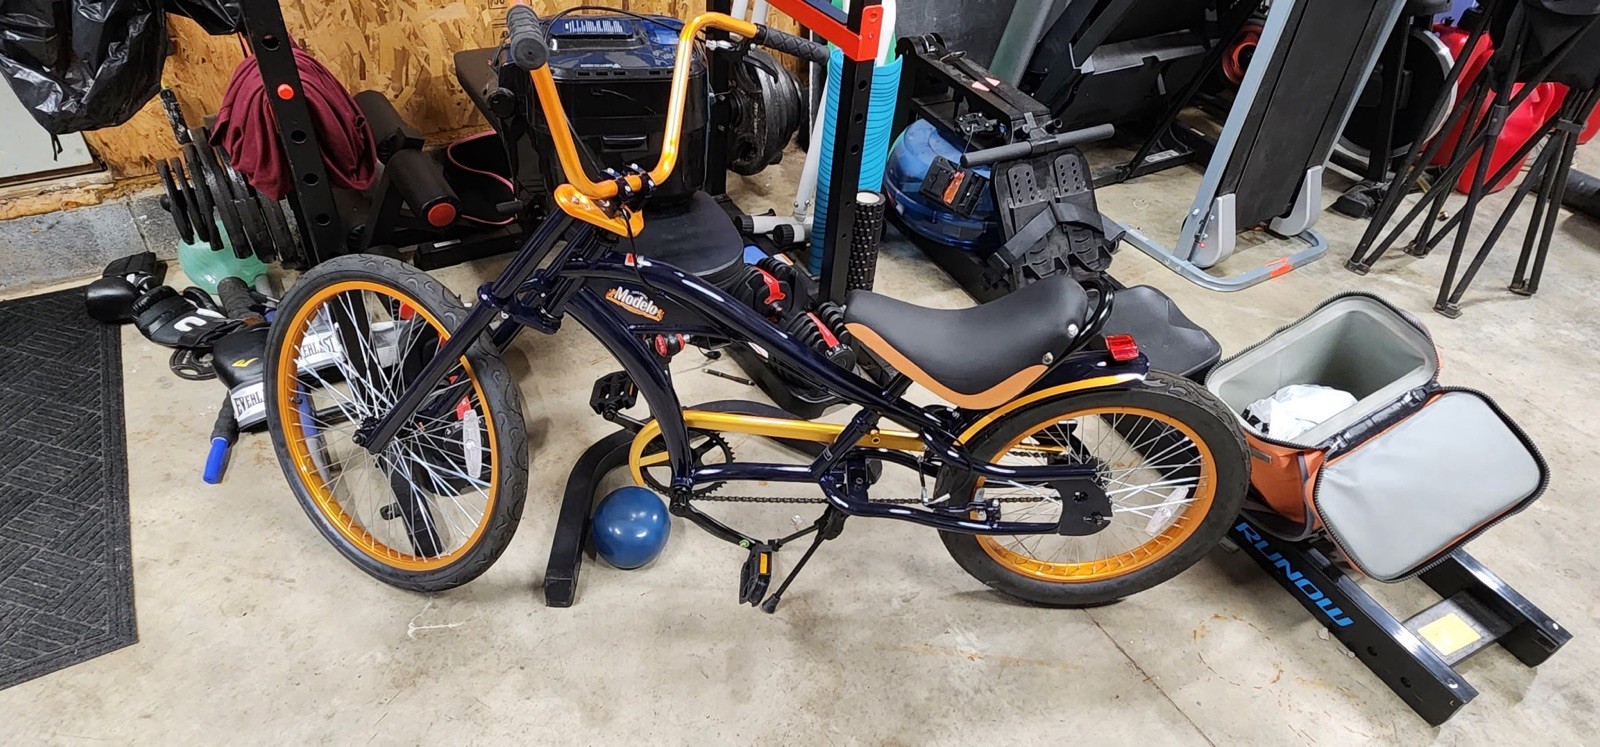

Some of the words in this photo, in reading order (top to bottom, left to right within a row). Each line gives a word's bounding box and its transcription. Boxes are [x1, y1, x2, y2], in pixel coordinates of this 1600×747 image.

[614, 286, 659, 315] Modelo
[302, 334, 339, 358] ERLAST
[233, 391, 264, 416] EVERL
[1235, 522, 1354, 627] RUNOW
